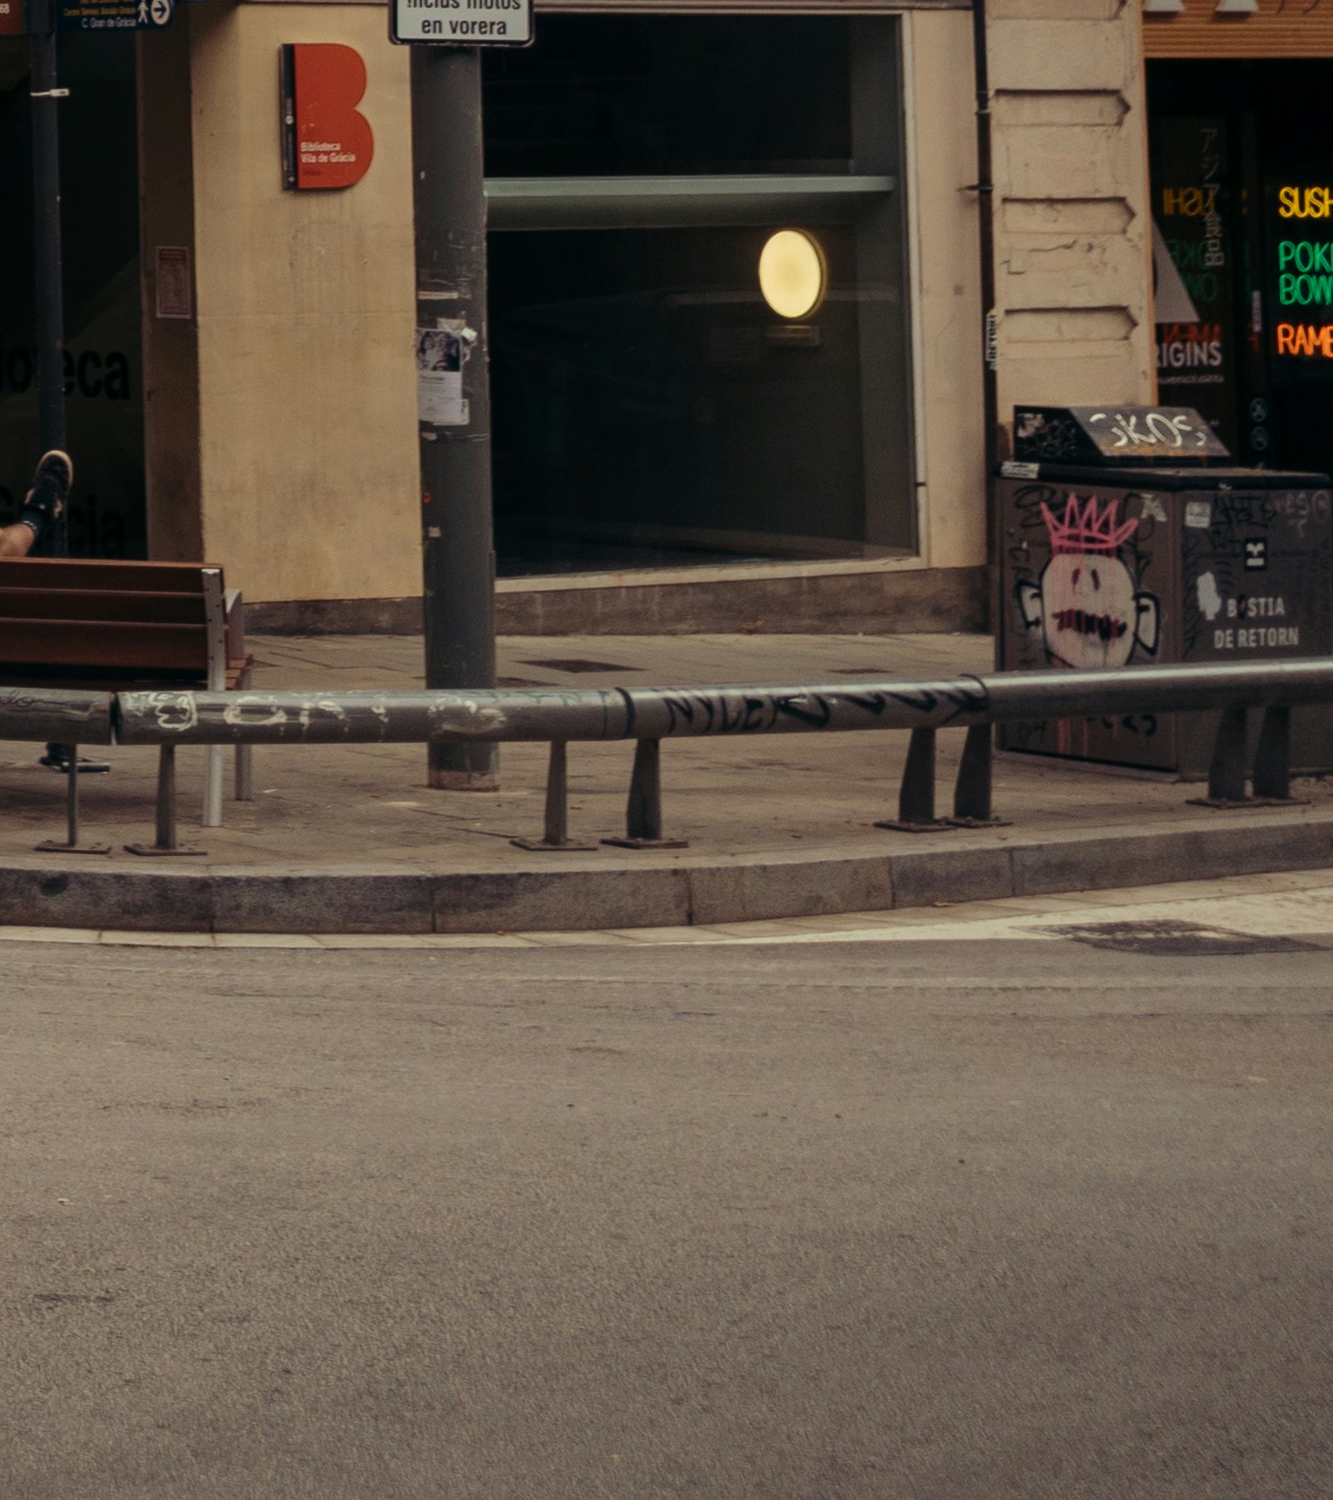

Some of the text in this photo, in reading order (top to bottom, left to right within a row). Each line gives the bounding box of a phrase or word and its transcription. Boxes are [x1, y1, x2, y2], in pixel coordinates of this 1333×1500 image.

[421, 19, 507, 35] en vorera
[1226, 597, 1286, 618] BSTIA
[1213, 626, 1300, 649] DE RETORN
